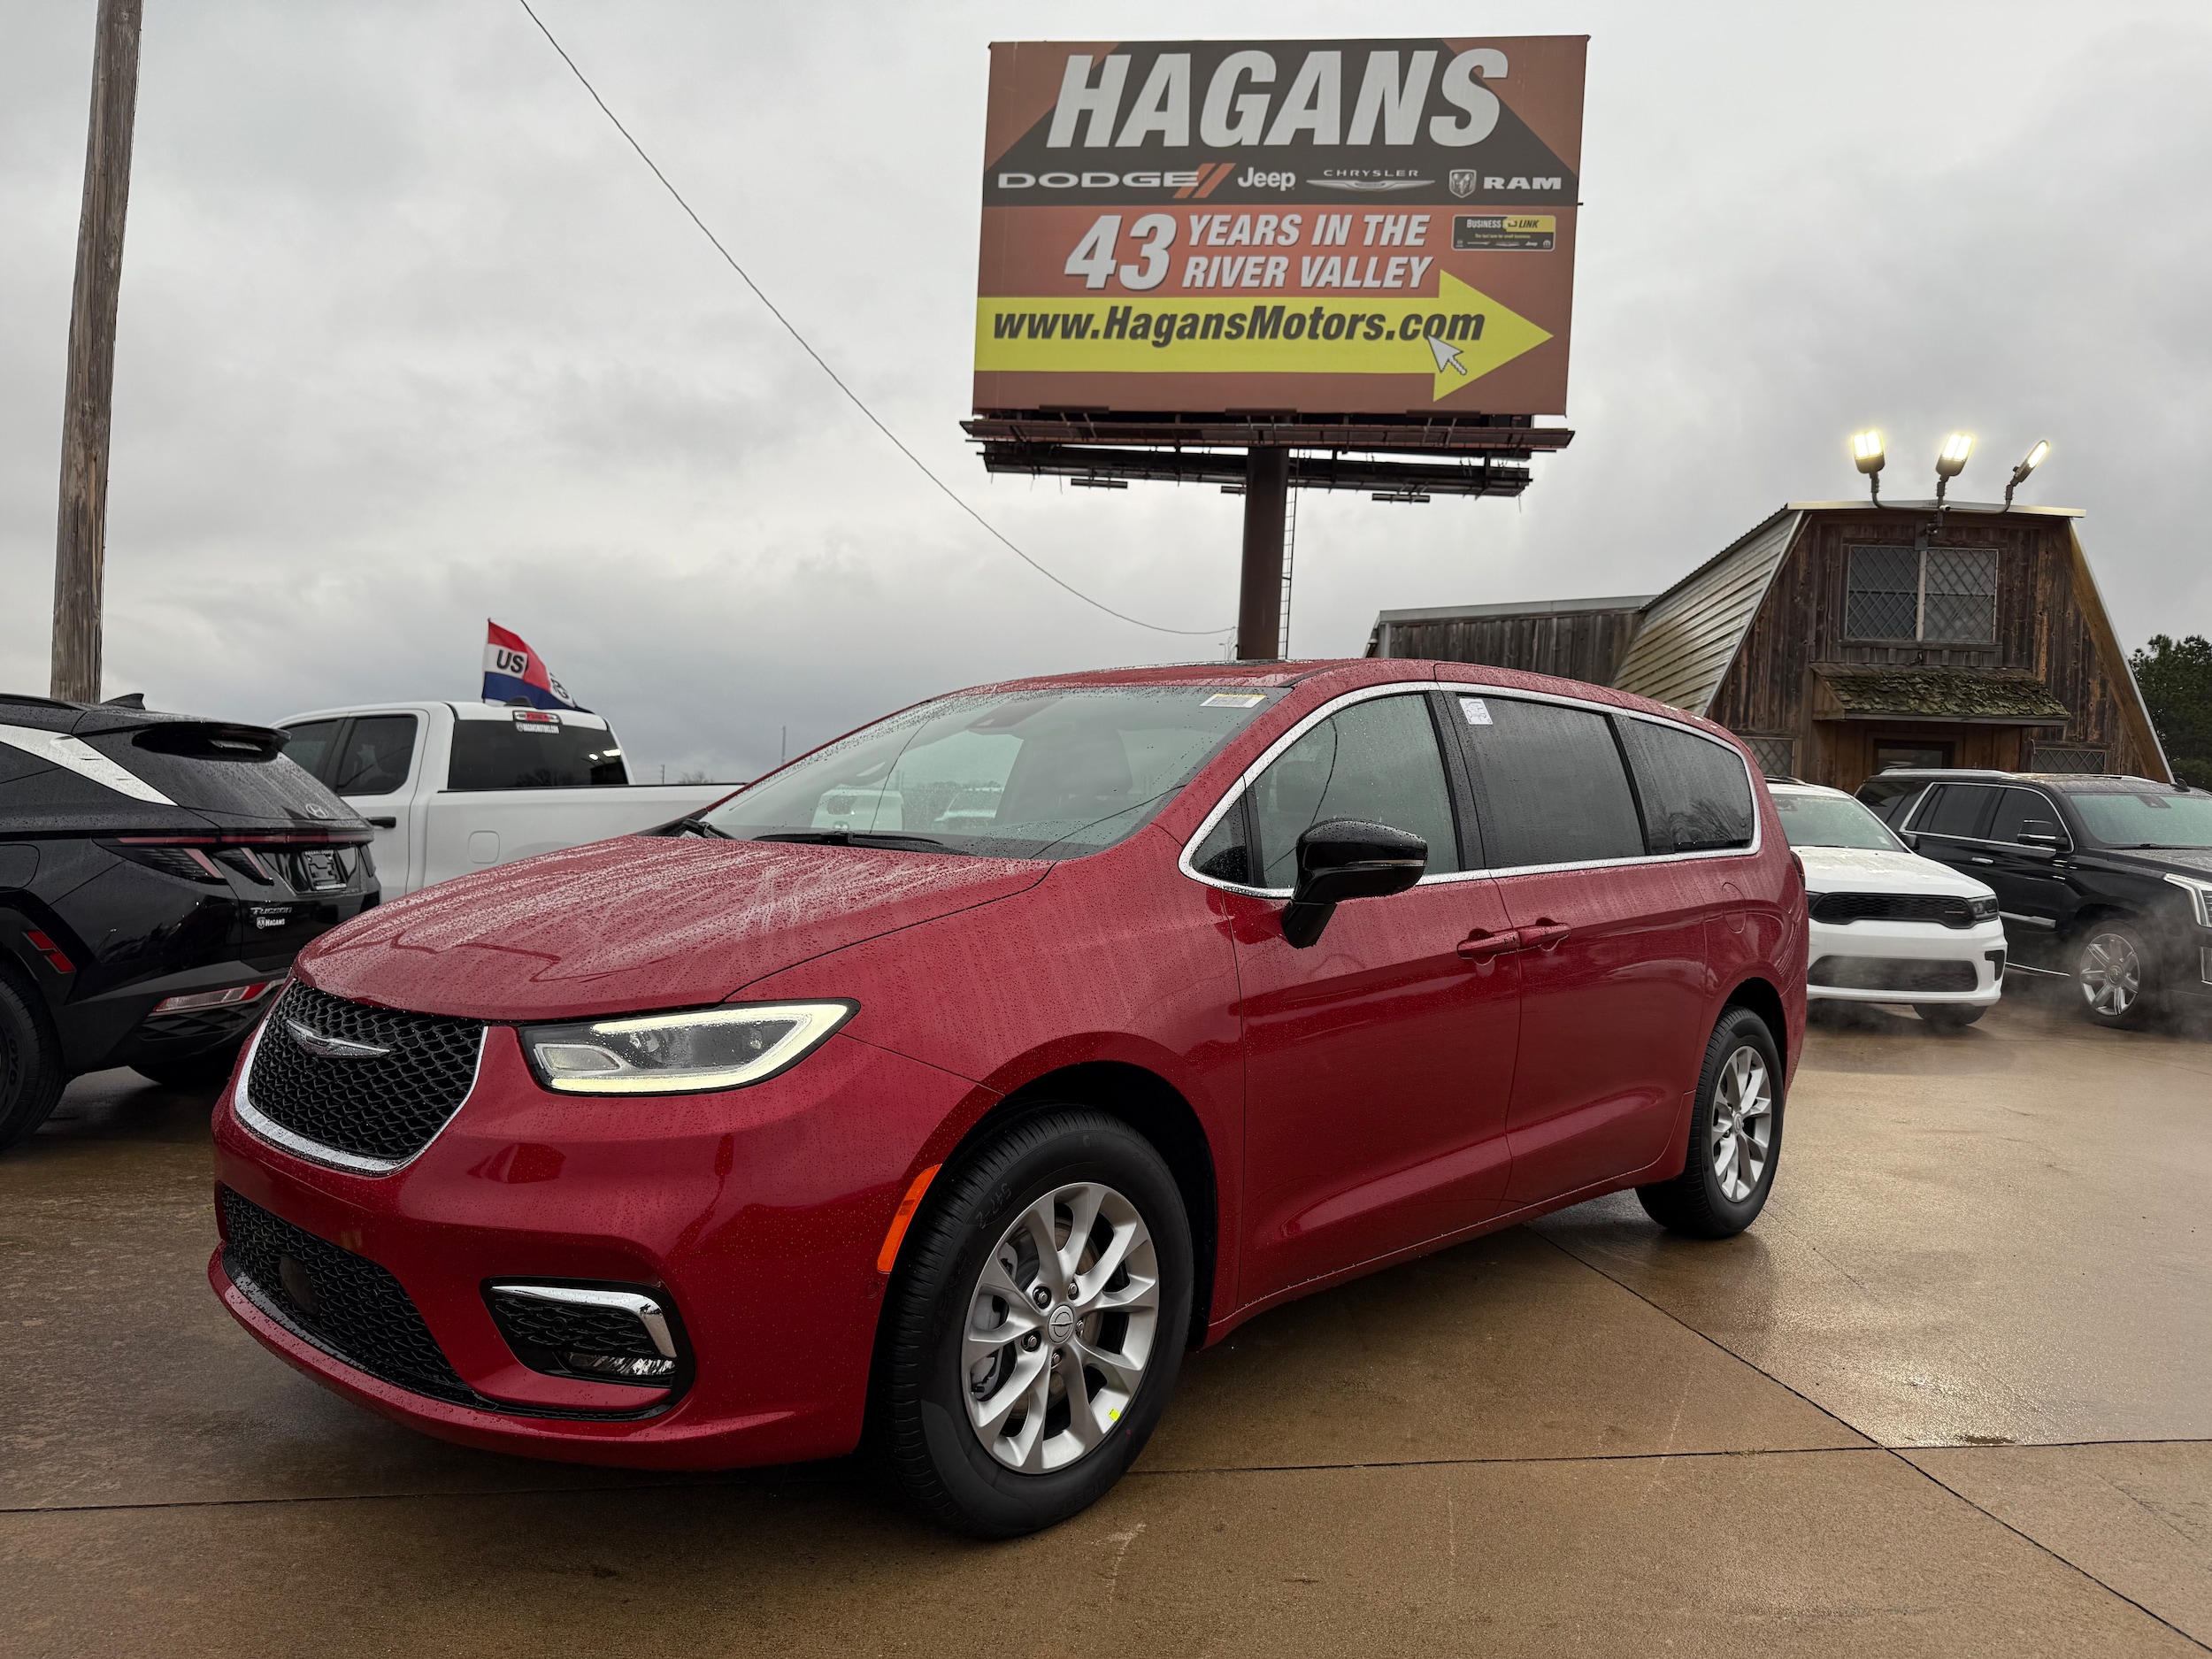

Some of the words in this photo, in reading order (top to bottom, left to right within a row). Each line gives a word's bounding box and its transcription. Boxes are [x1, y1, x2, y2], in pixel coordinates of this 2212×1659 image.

[1046, 47, 1509, 148] HAGANS
[998, 171, 1200, 188] DODGE
[1237, 166, 1296, 191] Jeep
[1483, 176, 1562, 190] RAM
[1188, 214, 1302, 247] YEARS
[1310, 214, 1353, 247] IN
[1363, 214, 1432, 247] THE
[1466, 219, 1502, 229] BUSINESS
[1518, 219, 1540, 229] LINK
[1064, 213, 1178, 290] 43
[1181, 256, 1289, 288] RIVER
[1299, 256, 1434, 288] VALLEY
[993, 304, 1486, 349] www.HagansMotors.com
